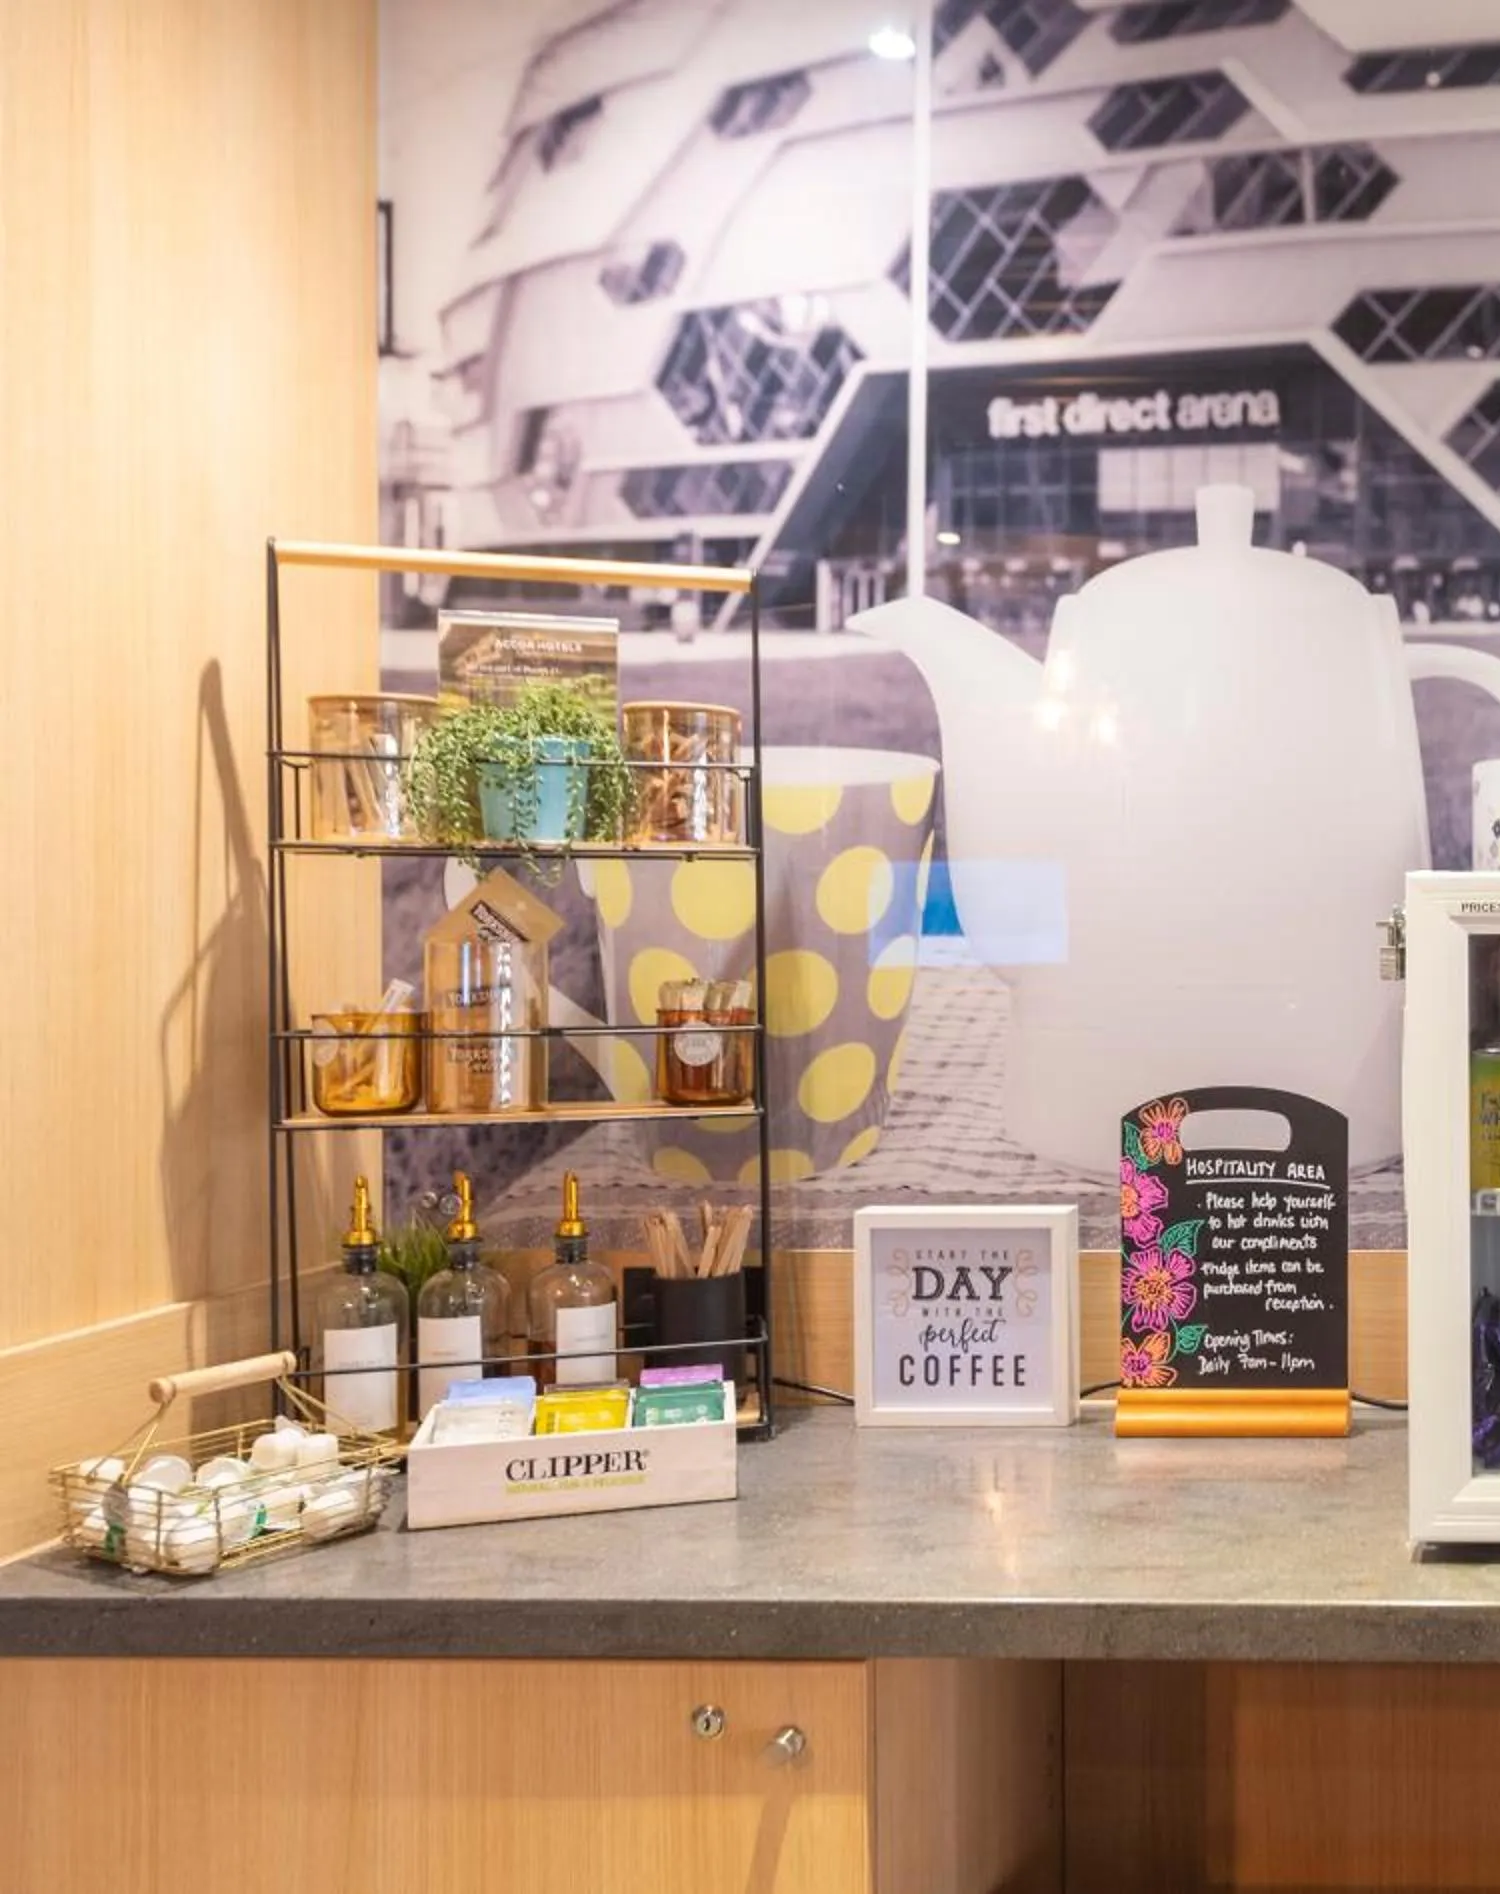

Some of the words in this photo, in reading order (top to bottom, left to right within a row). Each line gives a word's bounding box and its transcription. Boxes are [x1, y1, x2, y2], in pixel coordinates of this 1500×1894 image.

[987, 397, 1060, 438] first
[1062, 389, 1172, 434] direct
[1176, 389, 1280, 430] arena
[1185, 1157, 1276, 1178] HOSPITALITY
[1287, 1162, 1326, 1181] AREA
[1205, 1191, 1245, 1210] Please
[1251, 1191, 1277, 1210] help
[1283, 1193, 1336, 1213] yourself
[1208, 1214, 1222, 1230] to
[1227, 1212, 1247, 1229] hot
[1253, 1211, 1295, 1229] drinks
[1301, 1212, 1329, 1230] with
[1212, 1235, 1236, 1249] our
[1241, 1233, 1318, 1252] compliments
[916, 1249, 967, 1260] START
[980, 1249, 1008, 1260] THE
[1245, 1258, 1277, 1275] items
[1281, 1260, 1301, 1274] can
[1305, 1257, 1325, 1274] be
[912, 1265, 1013, 1301] DAY
[1203, 1279, 1262, 1300] purchased
[1265, 1279, 1297, 1295] from
[922, 1307, 961, 1317] WITH
[975, 1307, 1003, 1317] THE
[918, 1317, 1007, 1354] perfect
[1204, 1329, 1251, 1353] Opening
[899, 1354, 1025, 1387] COFFEE
[1198, 1354, 1231, 1376] Daily
[505, 1449, 648, 1482] CLIPPER
